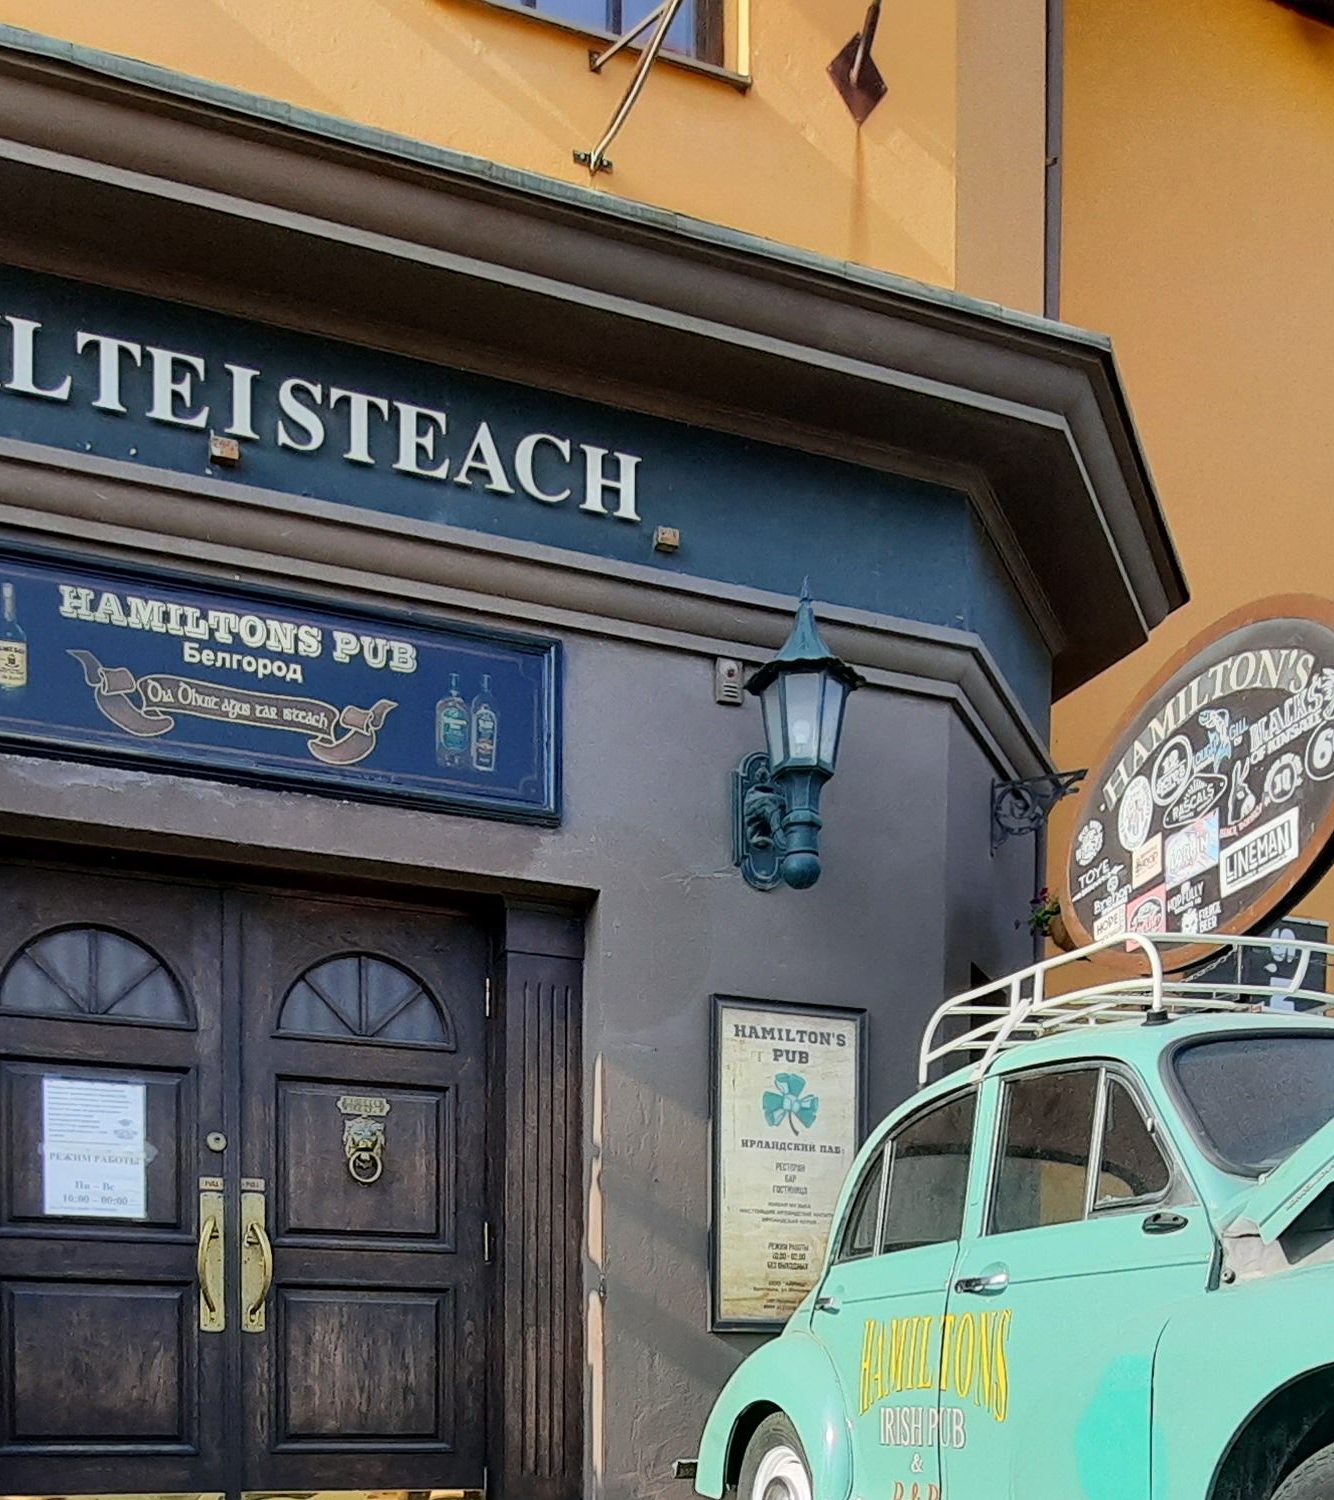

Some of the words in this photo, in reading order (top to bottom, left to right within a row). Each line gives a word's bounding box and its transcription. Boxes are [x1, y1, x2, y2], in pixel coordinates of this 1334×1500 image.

[58, 585, 322, 658] HAMILTONS
[332, 631, 417, 673] PUB
[182, 641, 303, 683] Белгород
[1249, 673, 1323, 751] BLACKS
[1102, 649, 1316, 812] HAMILTON'S
[1251, 747, 1266, 764] OF
[1267, 710, 1323, 754] KINSALE
[1172, 783, 1215, 820] RASCALS
[1226, 822, 1291, 881] LINEMAN
[1077, 859, 1110, 889] TOYE
[1096, 913, 1118, 935] HOPE
[733, 1024, 847, 1047] HAMILTON'S
[772, 1048, 809, 1064] PUB
[49, 1152, 91, 1162] РЕЖИМ
[94, 1154, 140, 1165] РАБОТЫ
[819, 1144, 842, 1154] ПАБ
[784, 1174, 797, 1183] БАР
[62, 1194, 90, 1204] 10:00
[859, 1308, 1012, 1422] HAMILTONS
[879, 1406, 924, 1447] IRISH
[927, 1407, 967, 1449] PUB
[910, 1452, 925, 1473] &
